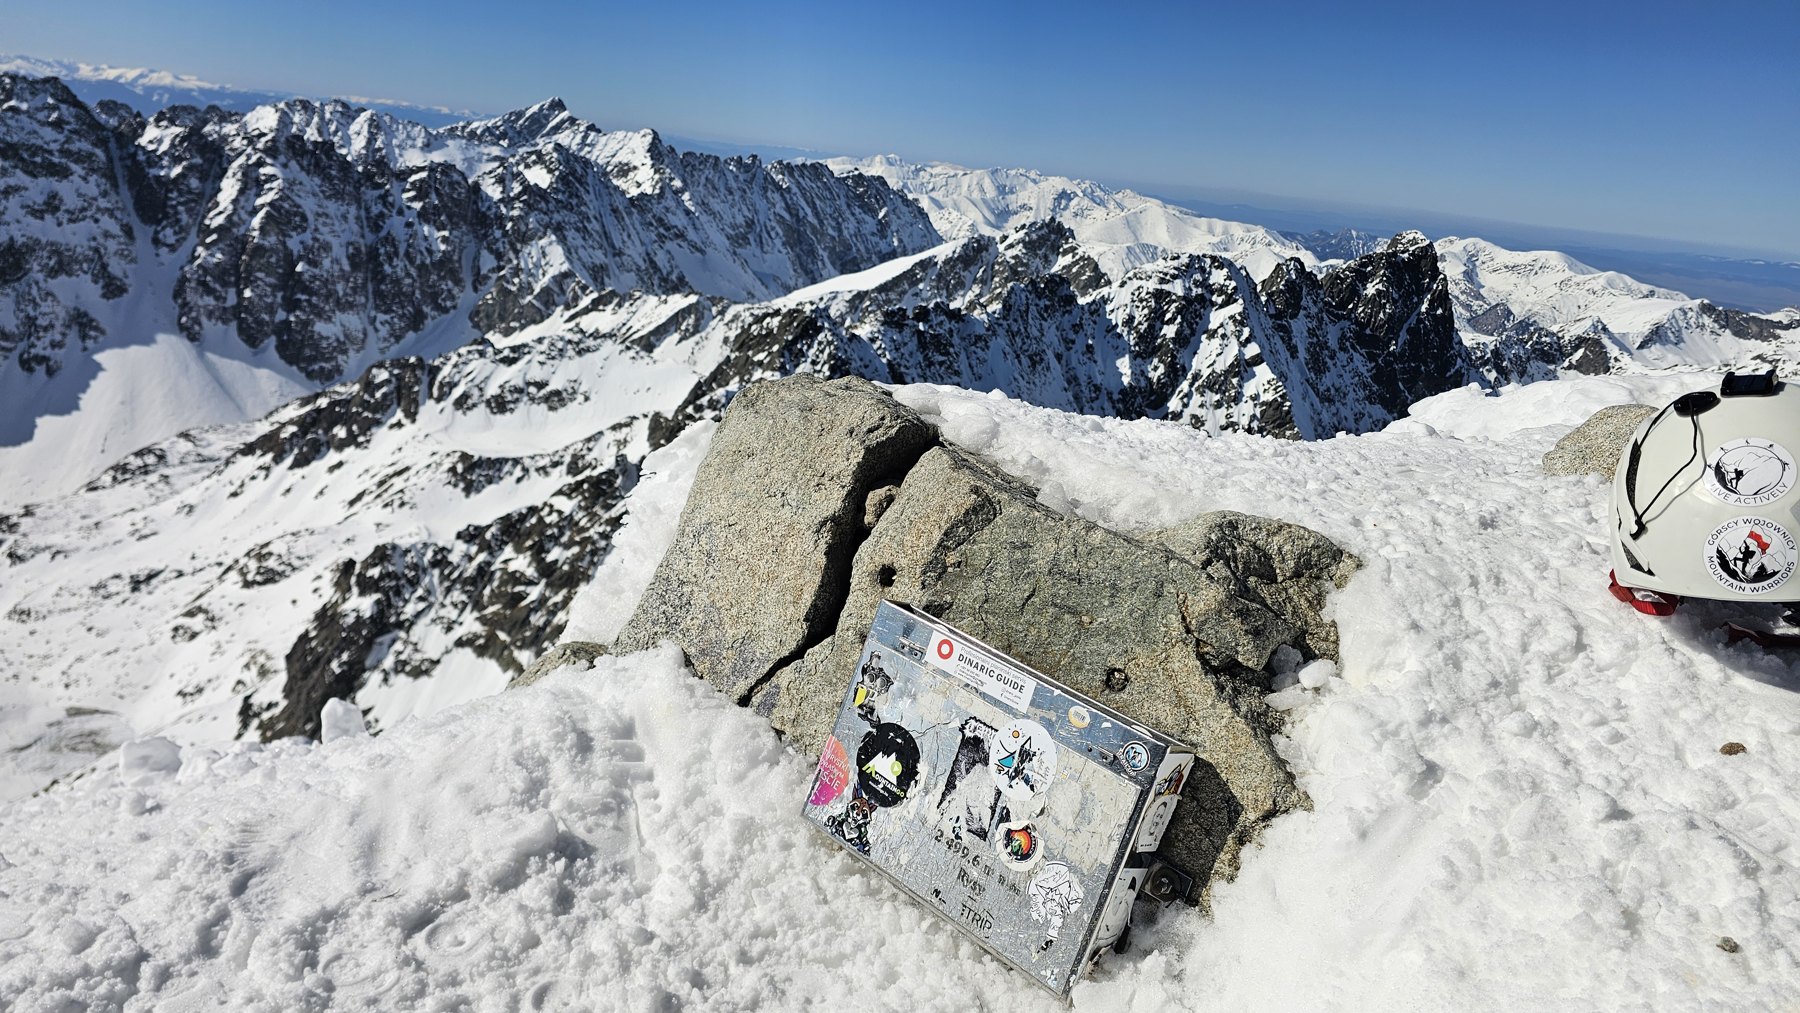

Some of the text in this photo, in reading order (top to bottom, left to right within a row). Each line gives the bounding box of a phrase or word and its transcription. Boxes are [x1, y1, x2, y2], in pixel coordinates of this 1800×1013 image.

[1710, 482, 1788, 504] LIVE ACTIVELY
[1708, 518, 1797, 551] GÓRSCY WOJOWNICY
[1707, 556, 1795, 593] MOUNTAIN WARRIORS
[958, 653, 995, 678] DINARIC
[996, 673, 1025, 694] GUIDE
